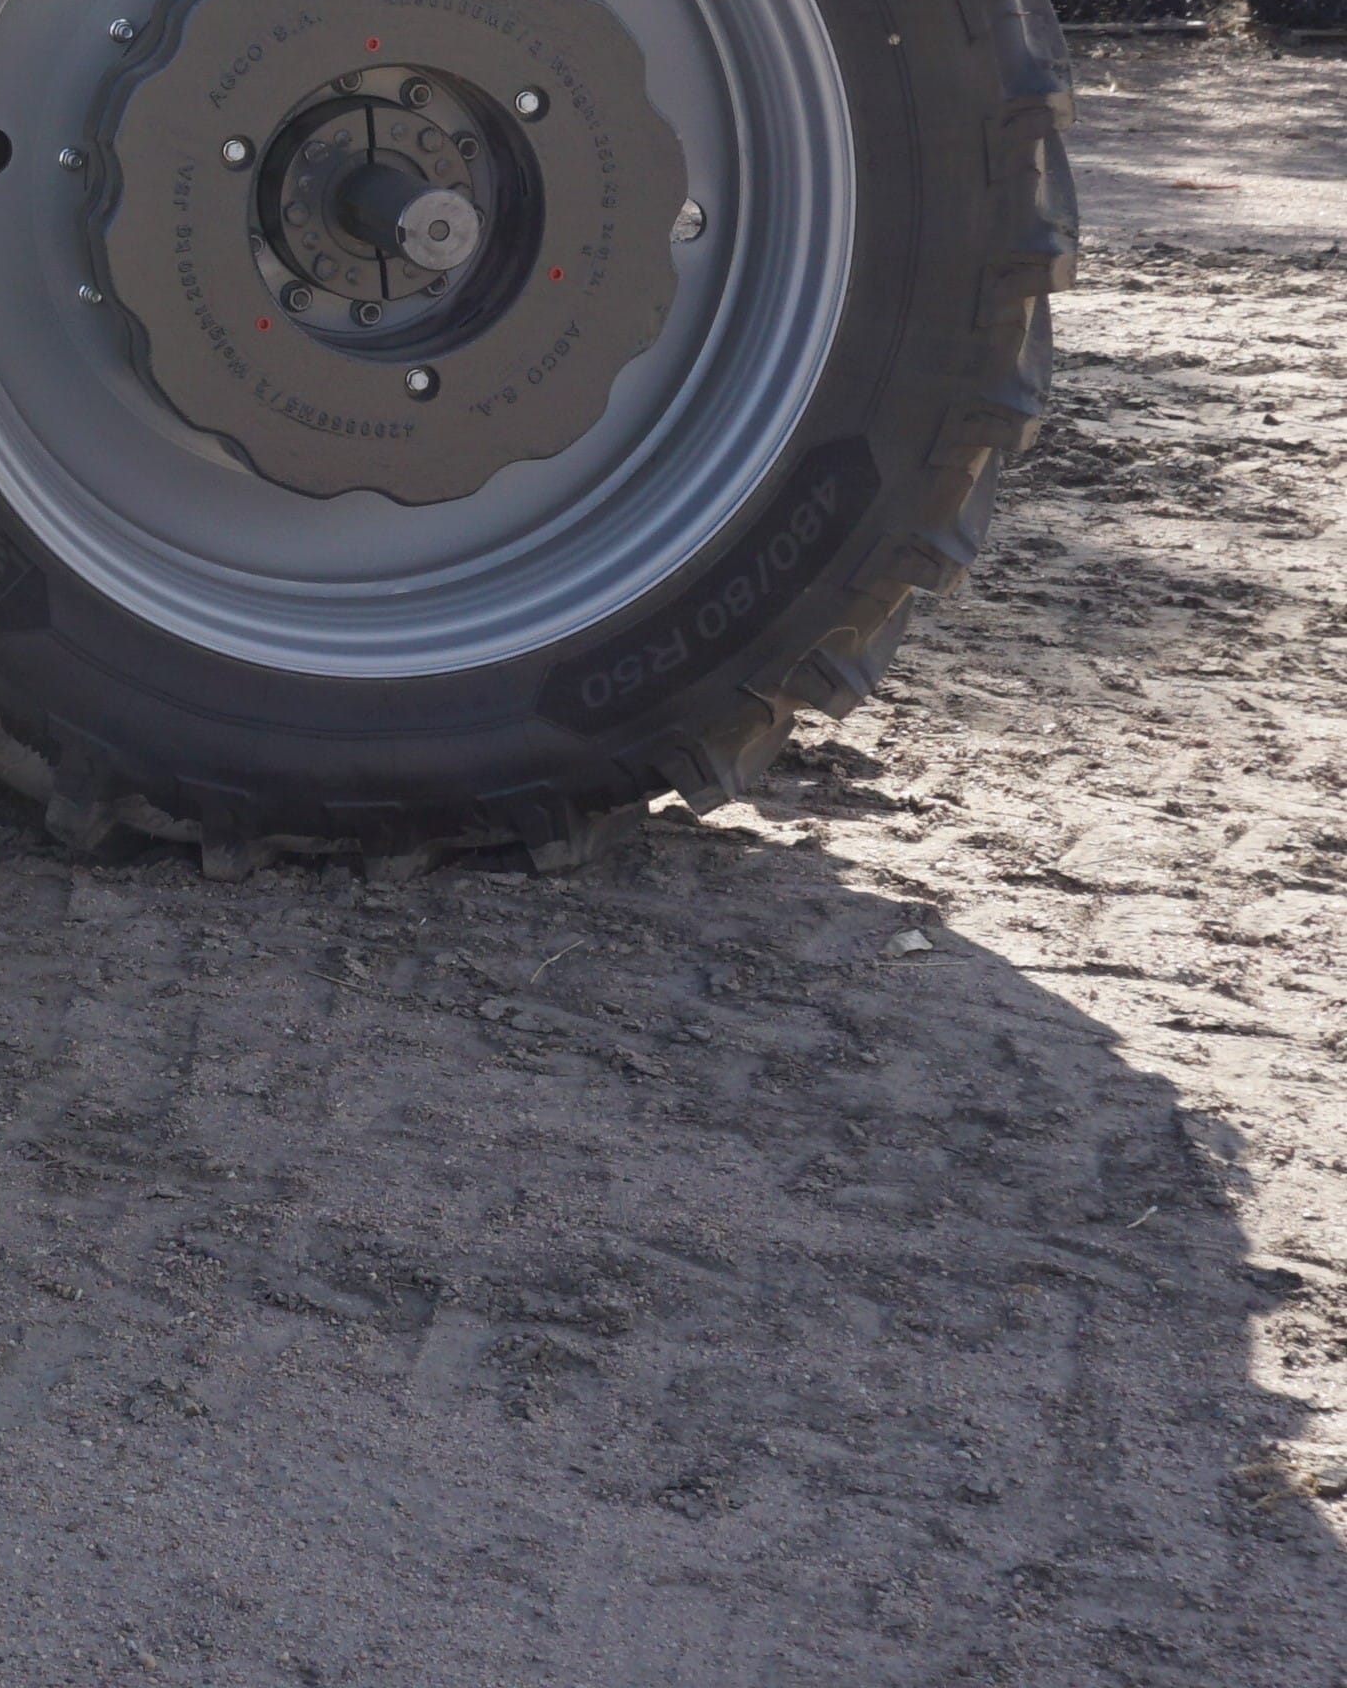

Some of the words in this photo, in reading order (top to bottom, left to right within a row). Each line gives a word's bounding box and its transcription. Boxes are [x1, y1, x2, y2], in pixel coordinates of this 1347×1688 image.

[207, 42, 264, 110] AGCO
[527, 318, 581, 387] AGCO
[696, 475, 837, 640] 480/80
[580, 629, 689, 708] R50
